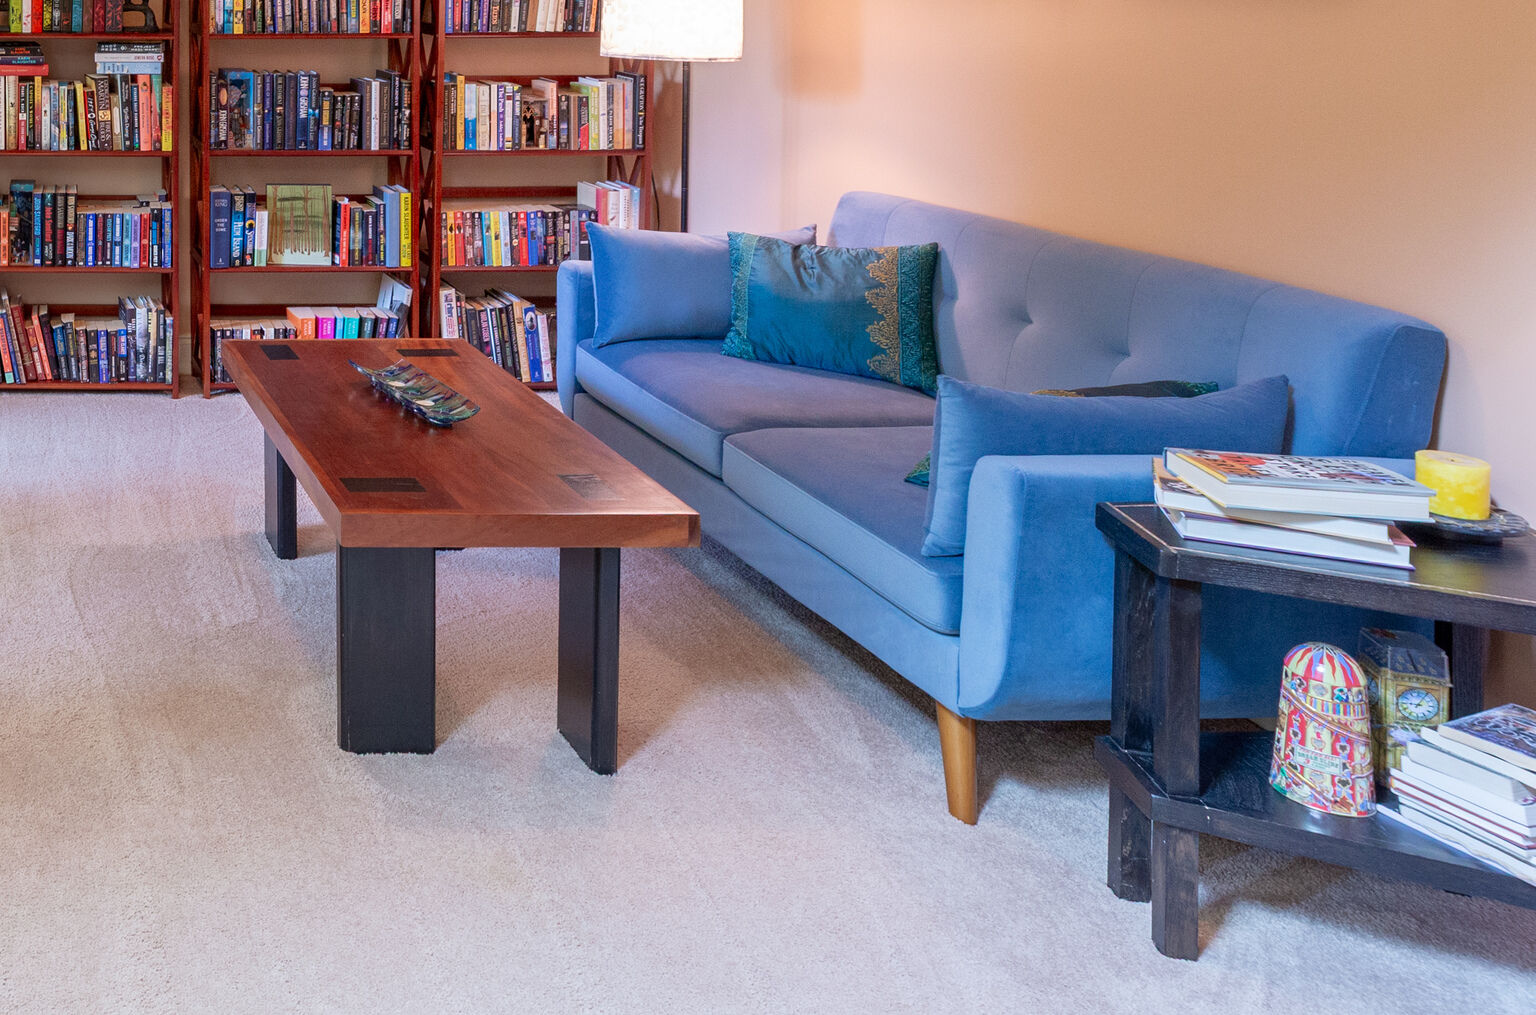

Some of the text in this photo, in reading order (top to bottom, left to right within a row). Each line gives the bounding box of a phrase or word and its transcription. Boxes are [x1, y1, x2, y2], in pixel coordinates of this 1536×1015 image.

[299, 75, 308, 119] JOHN GRISHAM
[219, 109, 228, 141] JOHN GRISHAM
[232, 221, 244, 258] PLUM ISLAND
